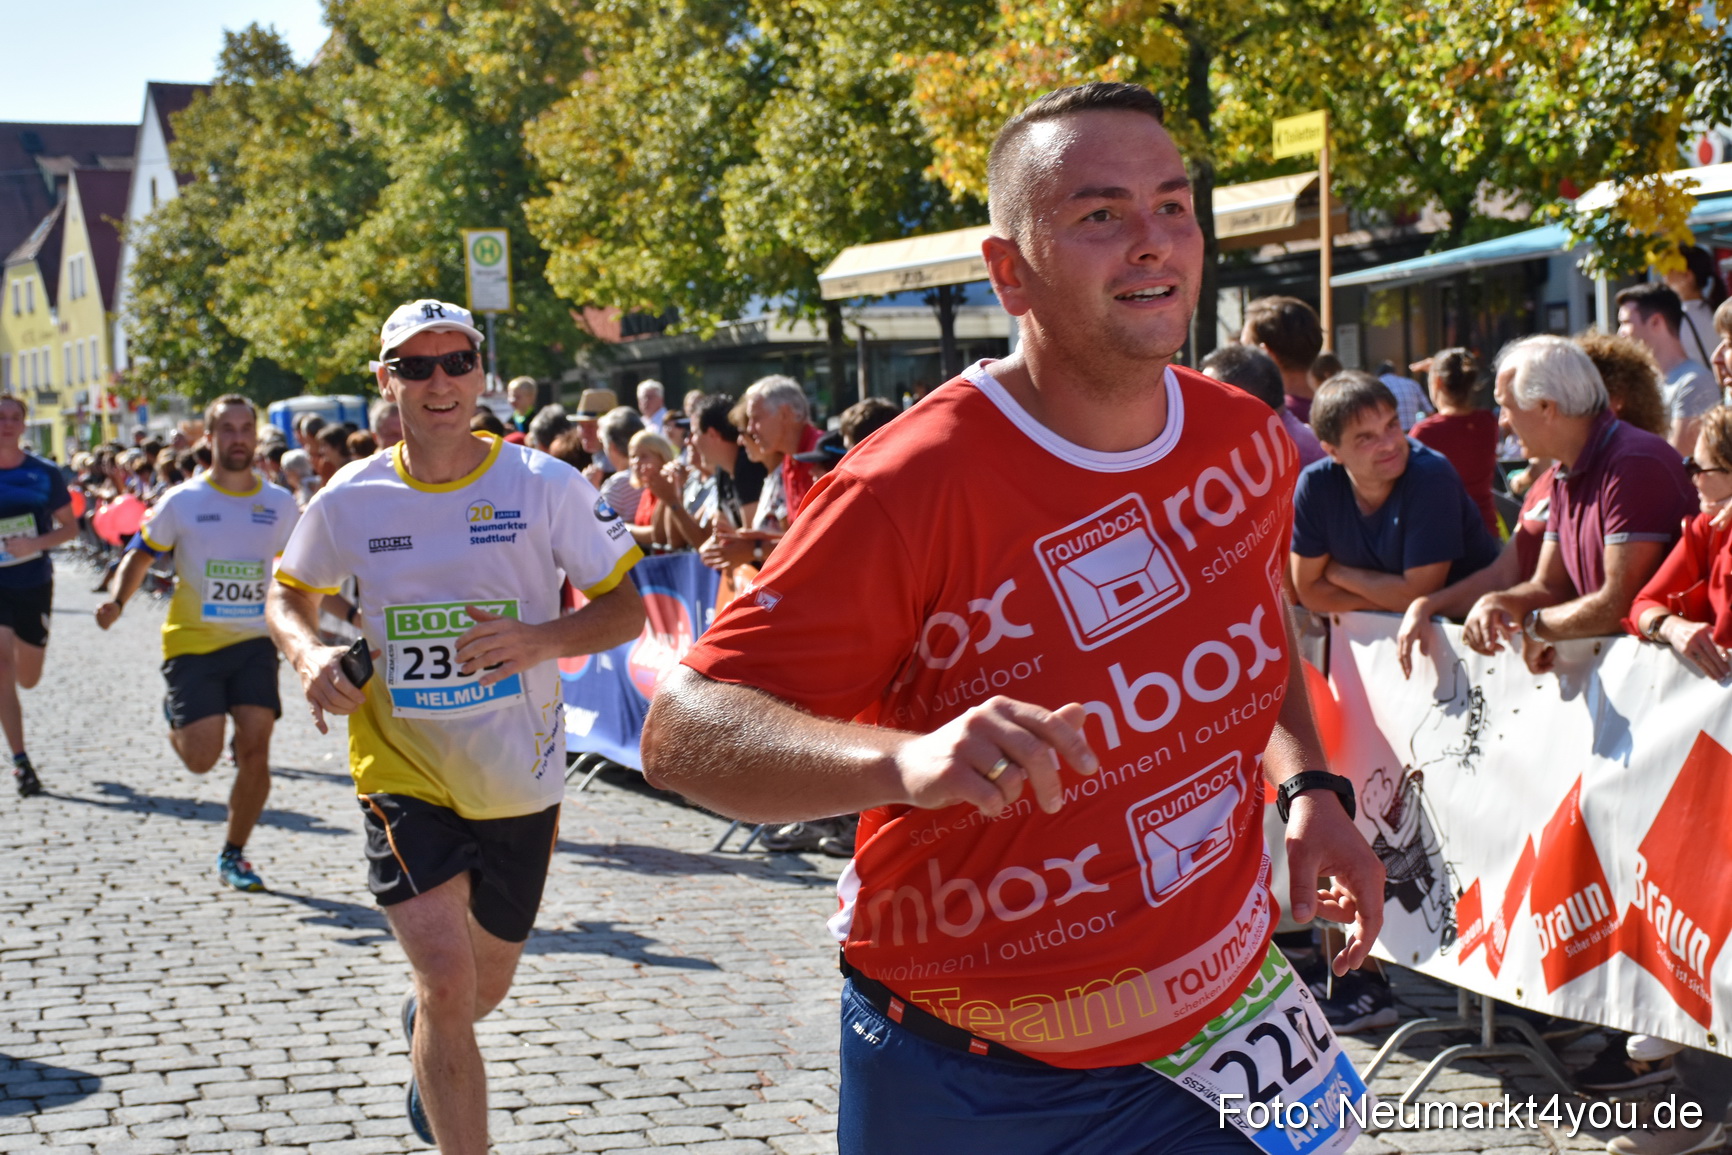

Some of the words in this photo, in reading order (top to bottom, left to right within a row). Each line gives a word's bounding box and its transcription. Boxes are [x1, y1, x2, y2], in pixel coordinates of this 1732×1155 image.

[470, 505, 493, 522] 20
[470, 522, 527, 533] Neumarkter
[1046, 507, 1143, 566] raumbox
[470, 533, 516, 545] Stadtlauf
[1201, 510, 1276, 584] schenken
[415, 681, 497, 706] HELMUT
[1062, 747, 1172, 805] wohnen
[1136, 764, 1236, 832] raumbox
[1532, 882, 1610, 960] Braun
[1632, 851, 1711, 980] Braun
[876, 953, 975, 982] wohnen
[999, 910, 1118, 960] outdoor
[1564, 937, 1591, 957] Sicher
[1656, 941, 1676, 974] Sicher
[1675, 966, 1688, 984] ist
[910, 966, 1158, 1043] Team
[1174, 984, 1222, 1018] schenken
[852, 1021, 881, 1044] DRI-FIT
